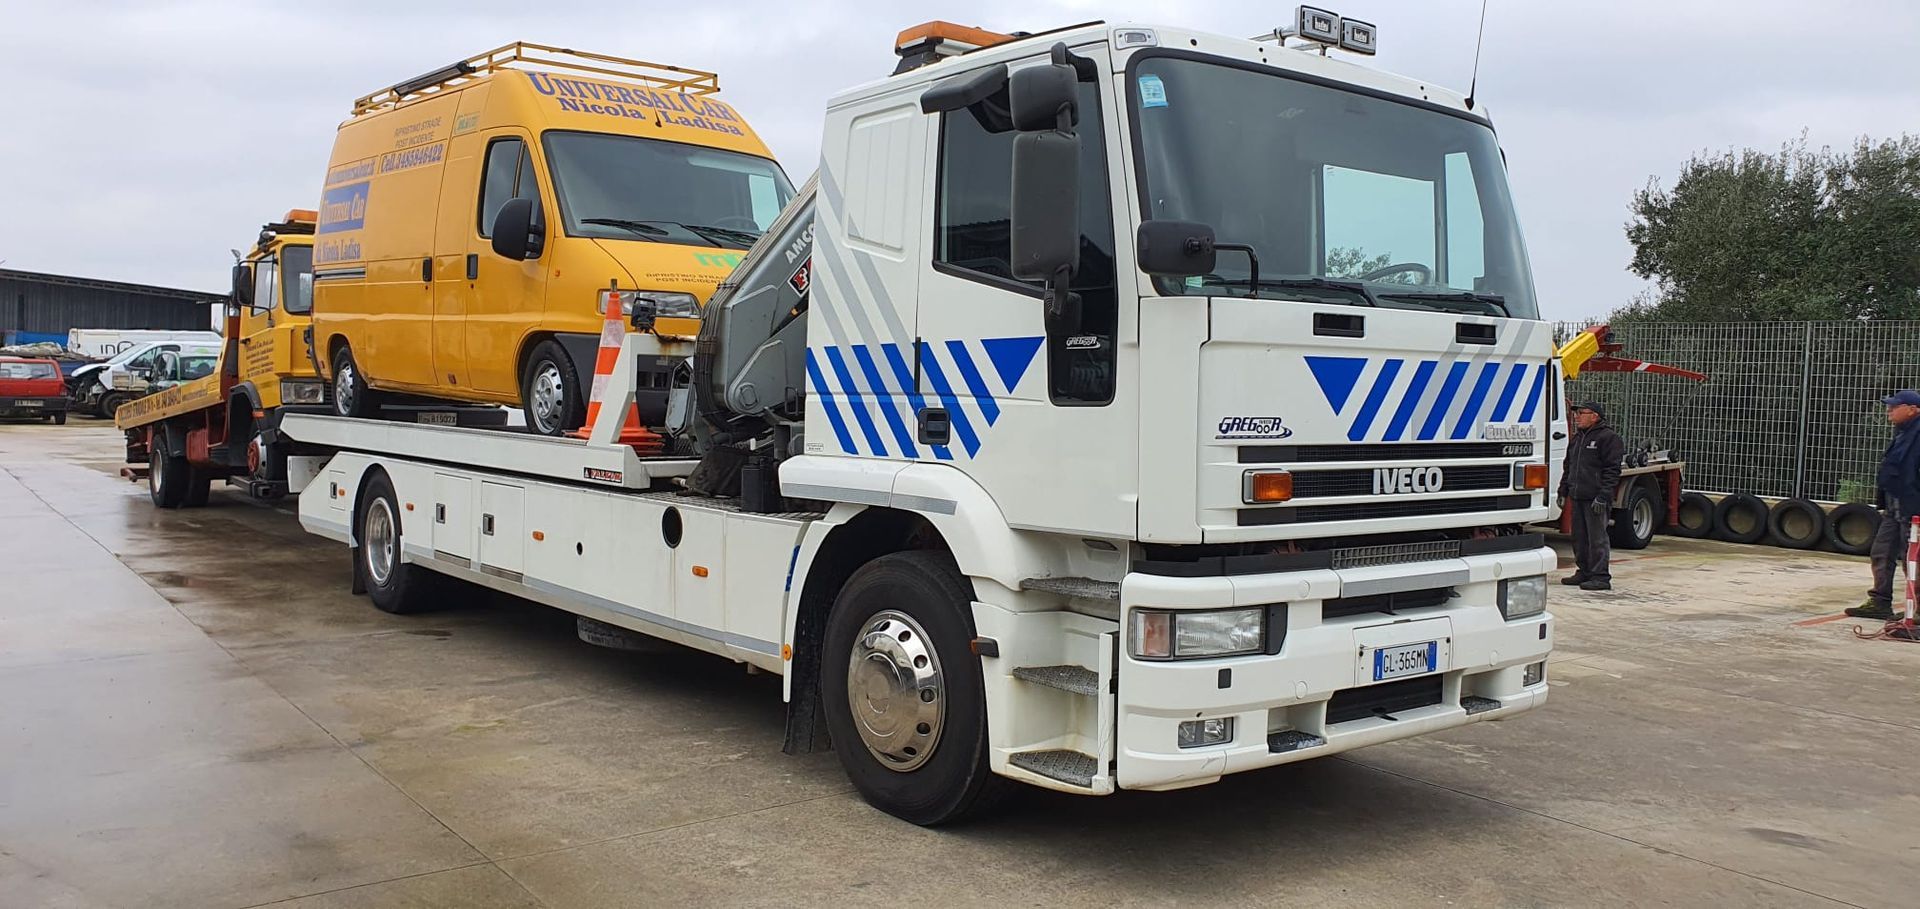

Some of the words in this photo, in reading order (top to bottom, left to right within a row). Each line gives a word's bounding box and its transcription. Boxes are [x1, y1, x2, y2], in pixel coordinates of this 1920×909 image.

[525, 71, 685, 113] UNIVERSAL
[678, 92, 738, 122] CAR
[557, 97, 646, 120] Nicola
[658, 110, 744, 137] Ladisa
[1373, 466, 1443, 495] IVECO
